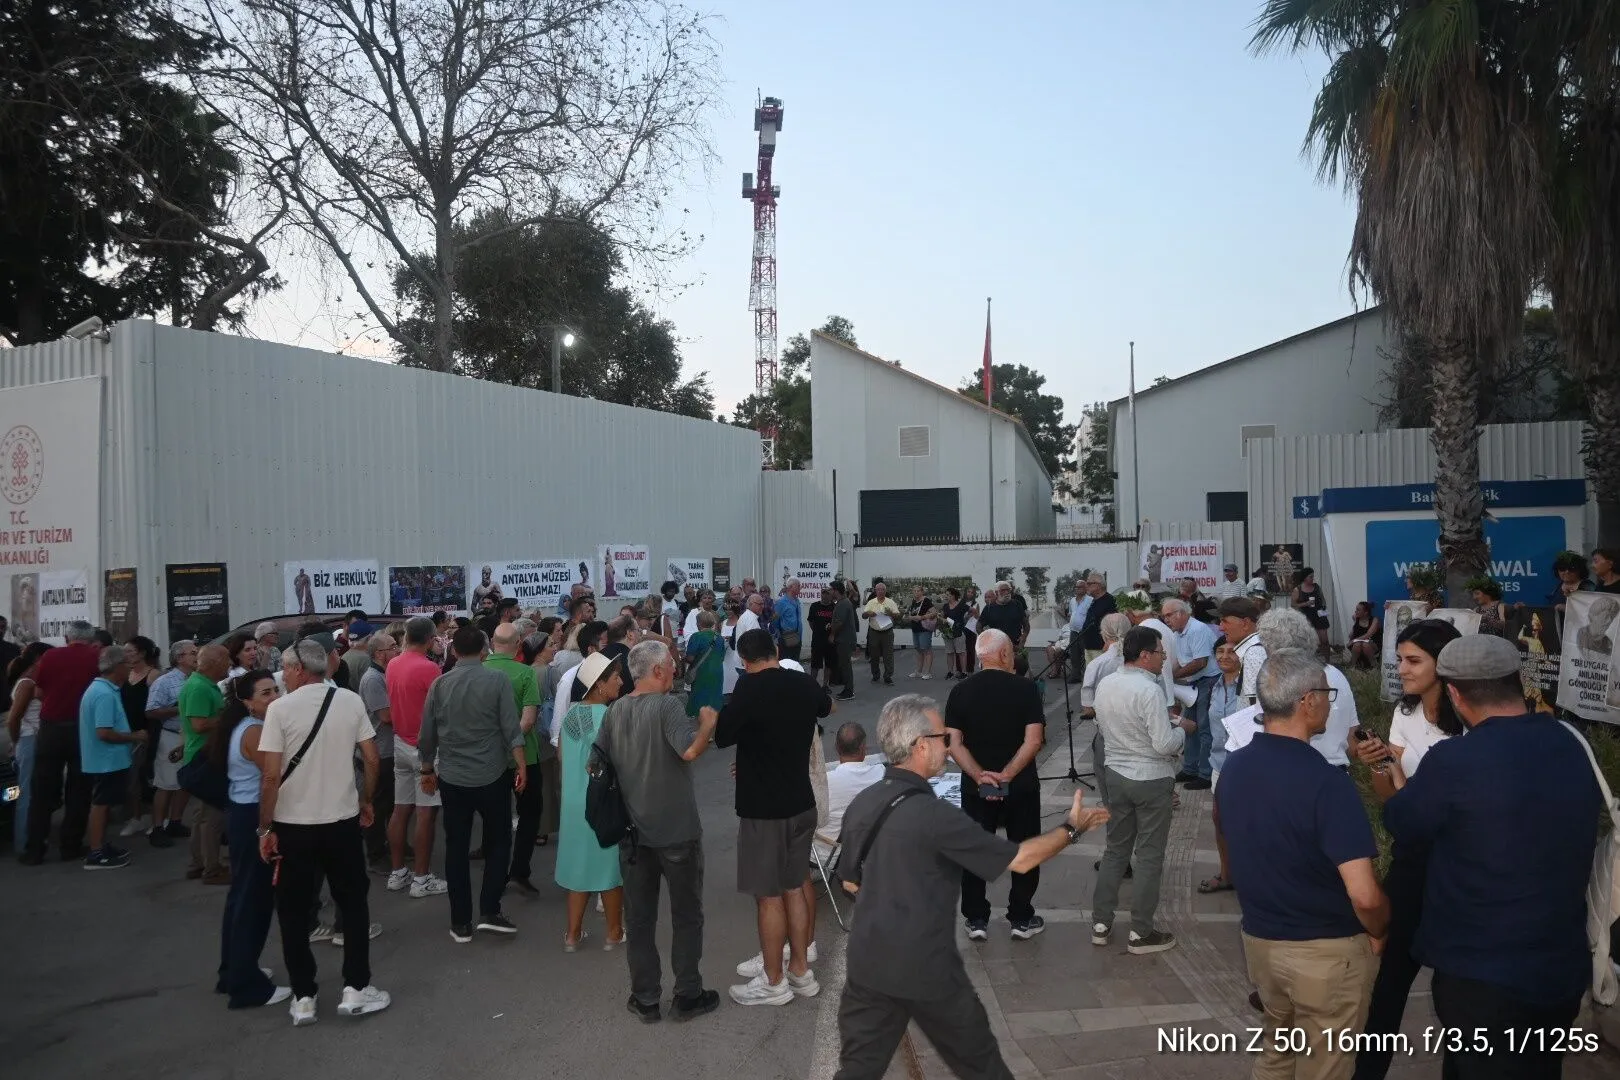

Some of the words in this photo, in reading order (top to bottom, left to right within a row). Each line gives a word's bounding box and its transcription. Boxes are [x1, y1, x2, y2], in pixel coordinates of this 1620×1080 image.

[10, 511, 29, 525] T.C.
[12, 530, 26, 544] VE
[28, 526, 73, 544] TURİZM
[1165, 544, 1188, 559] ÇEKİN
[1190, 543, 1217, 556] ELİNİZİ
[799, 561, 828, 569] MÜZENE
[1174, 561, 1207, 571] ANTALYA
[313, 570, 331, 587] BİZ
[334, 569, 377, 586] HERKÜL'ÜZ
[502, 573, 540, 585] ANTALYA
[541, 569, 571, 582] MÜZESİ
[797, 570, 817, 578] SAHİP
[818, 571, 831, 579] ÇIK
[514, 585, 561, 597] YIKILAMAZ!
[326, 593, 362, 609] HALKIZ
